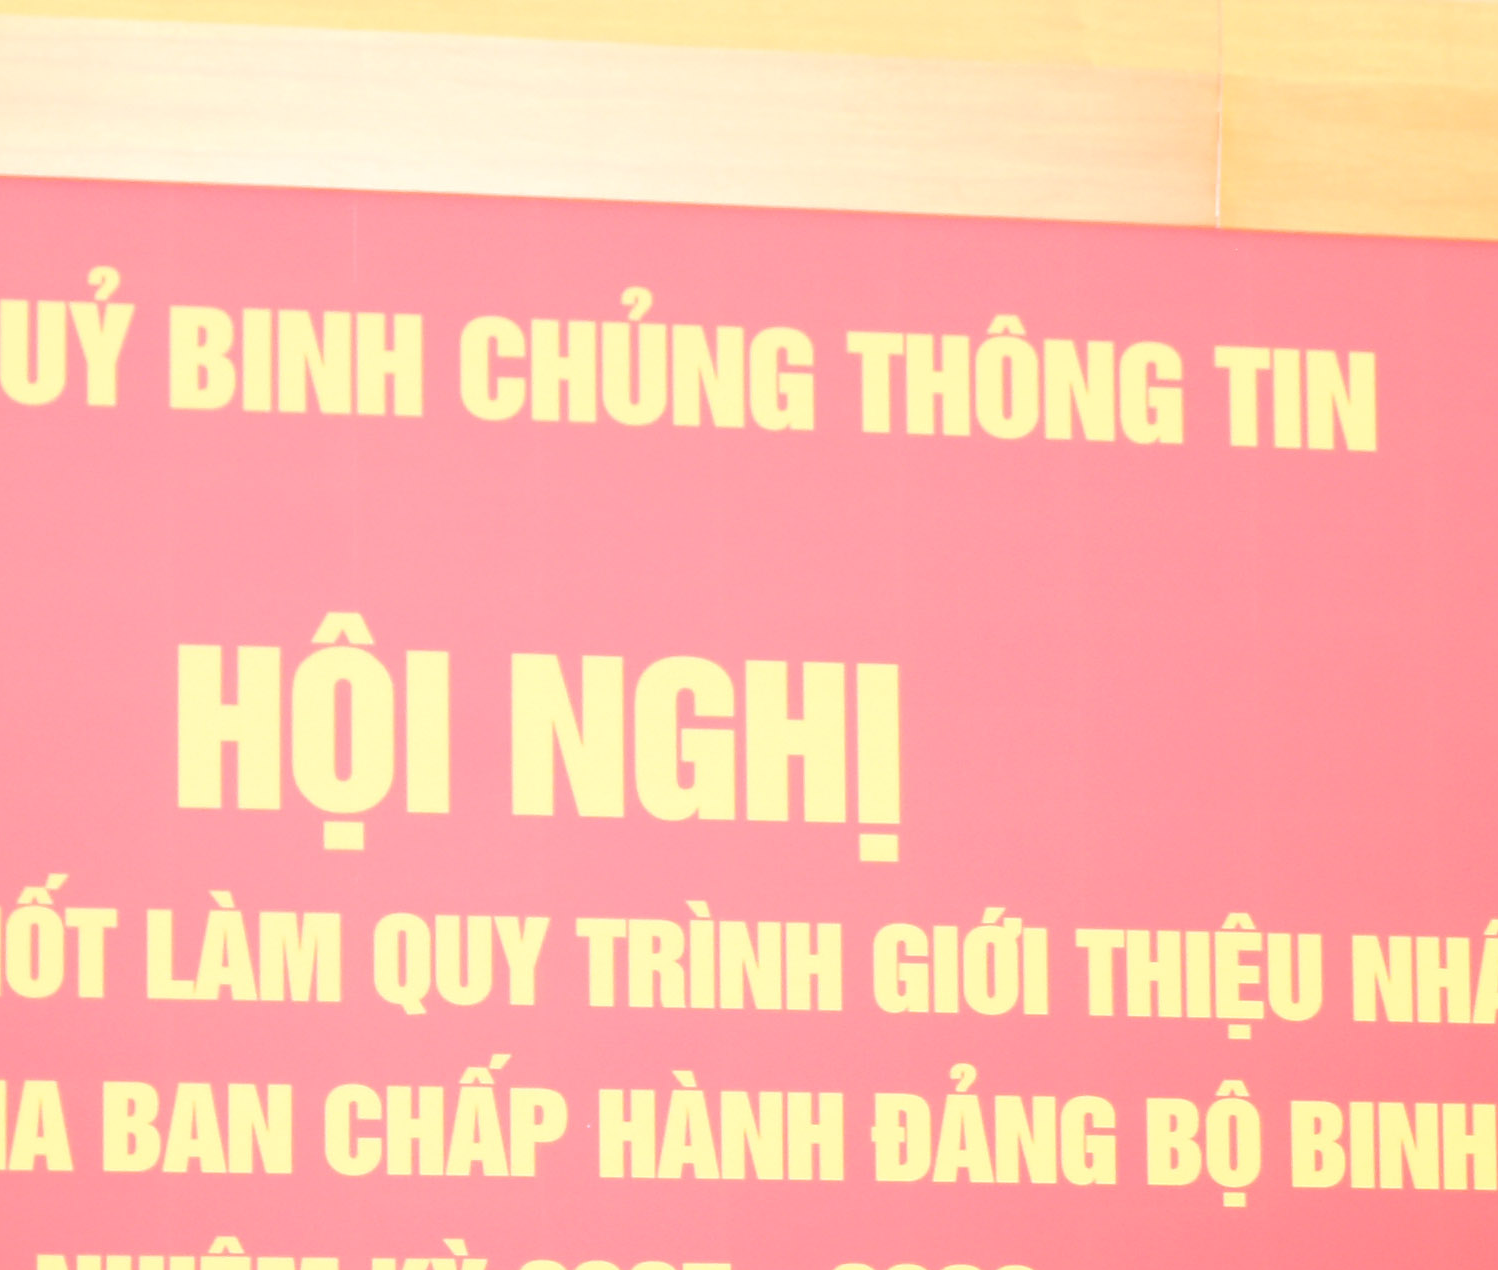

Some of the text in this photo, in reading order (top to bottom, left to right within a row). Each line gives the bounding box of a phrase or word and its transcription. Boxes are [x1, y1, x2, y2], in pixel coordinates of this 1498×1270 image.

[0, 266, 135, 407] UỶ
[169, 305, 423, 417] BINH
[460, 286, 814, 431] CHỦNG
[846, 314, 1183, 444] THÔNG
[1214, 346, 1377, 452] TIN
[178, 612, 900, 862] HỘI NGHỊ
[147, 890, 342, 1002] LÀM
[373, 912, 551, 1015] QUY
[575, 900, 843, 1011] TRÌNH
[873, 907, 1048, 1015] GIỚI
[1075, 912, 1323, 1040] THIỆU
[103, 1081, 293, 1174] BAN
[324, 1053, 568, 1177] CHẤP
[598, 1070, 844, 1181] HÀNH
[871, 1063, 1116, 1186] ĐẢNG
[1146, 1080, 1261, 1207] BỘ
[1291, 1100, 1497, 1190] BINH
